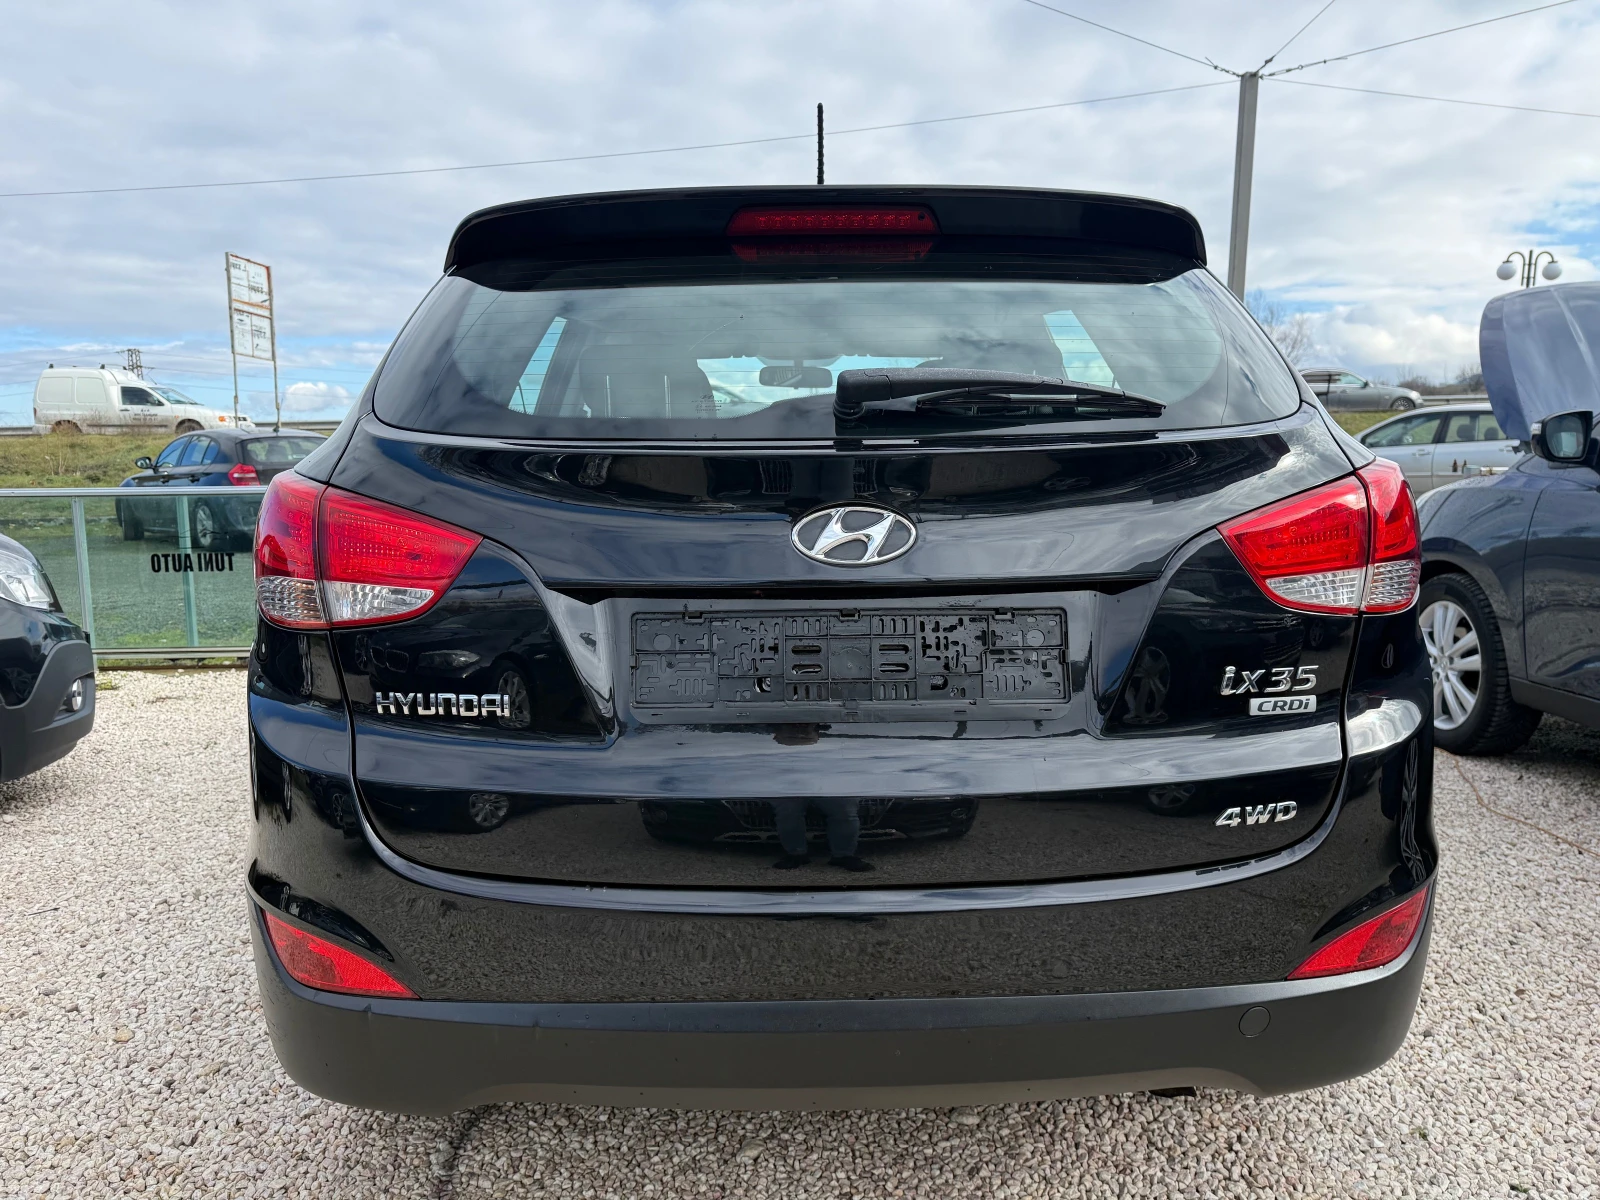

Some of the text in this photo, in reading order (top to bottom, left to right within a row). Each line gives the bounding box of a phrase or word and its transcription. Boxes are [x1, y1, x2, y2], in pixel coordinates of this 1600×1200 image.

[375, 691, 511, 717] HYUNDAI
[1257, 698, 1310, 712] CRDi
[1214, 801, 1297, 827] 4WD
